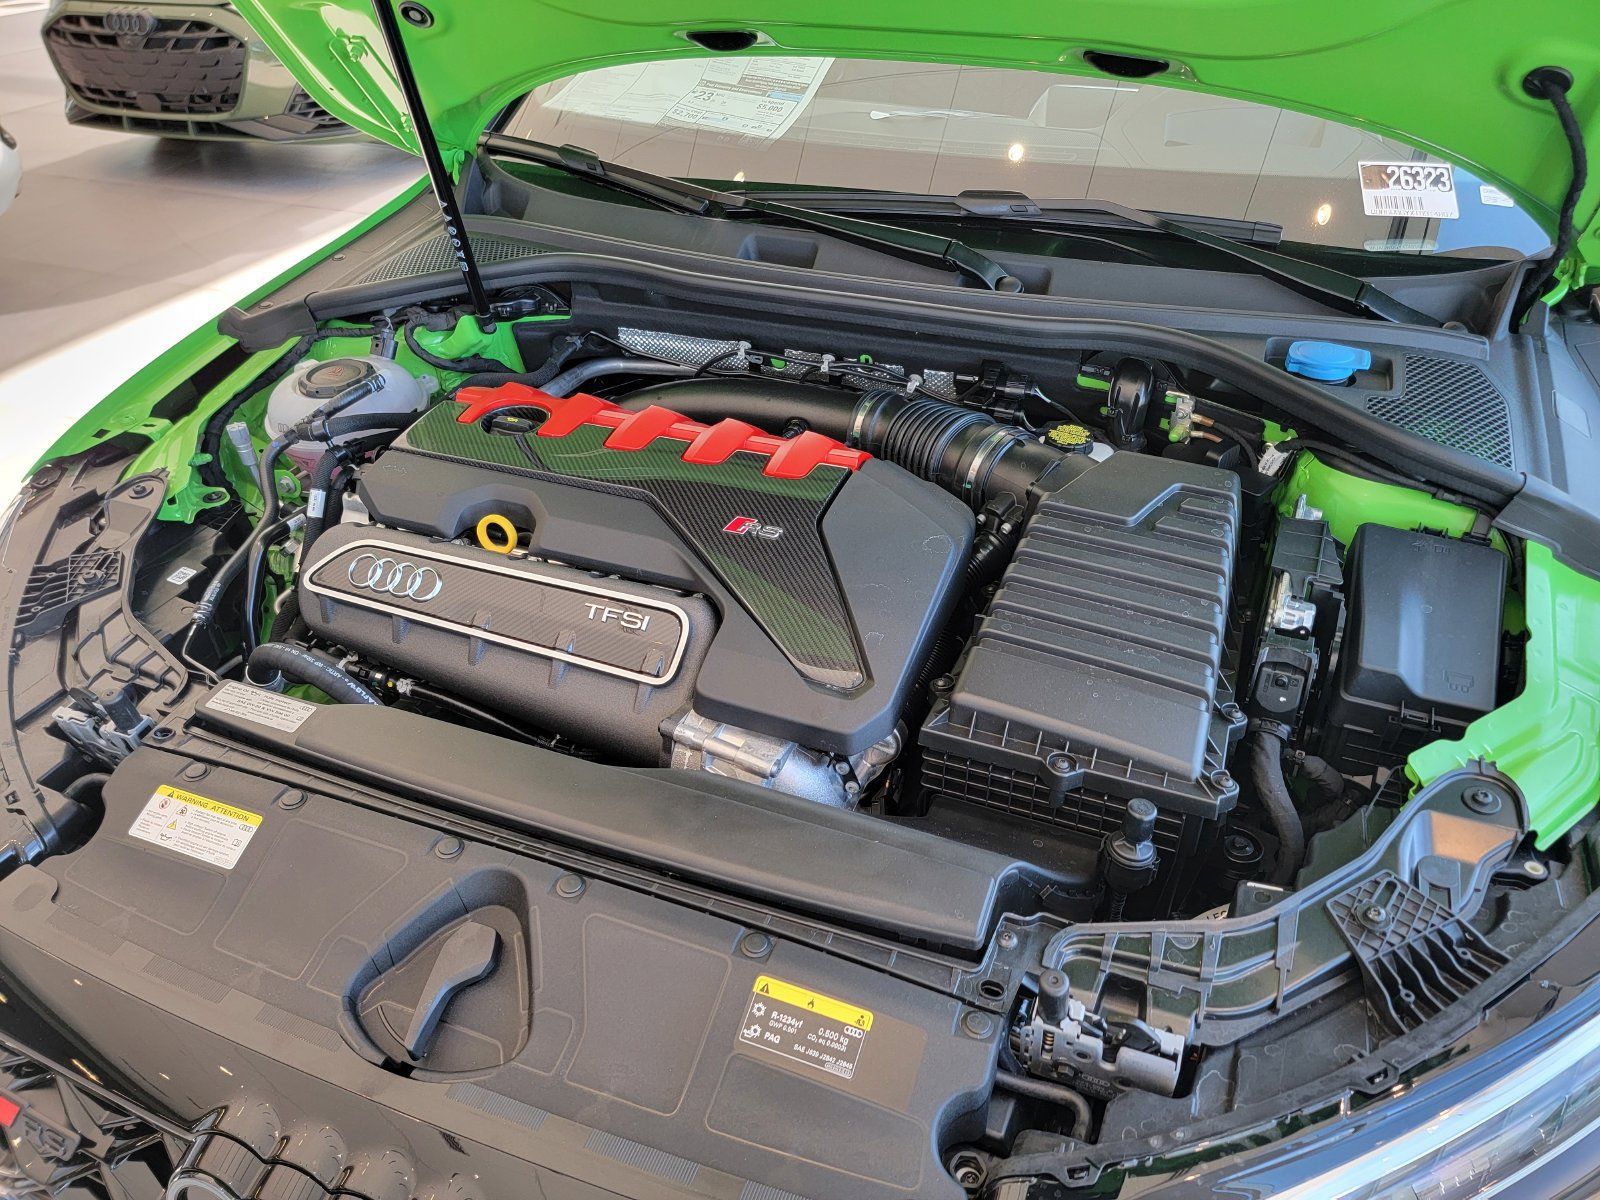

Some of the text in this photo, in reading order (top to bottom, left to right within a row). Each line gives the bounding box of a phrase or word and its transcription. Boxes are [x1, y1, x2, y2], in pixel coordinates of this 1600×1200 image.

[693, 91, 715, 101] 23
[1386, 166, 1450, 192] 26323
[733, 519, 783, 539] RS
[584, 602, 651, 631] TFSI
[176, 794, 208, 809] WARNING
[211, 805, 250, 822] ATTENTION
[771, 1011, 804, 1028] R-1234yf
[764, 1031, 781, 1044] PAG
[818, 1027, 849, 1046] 0.500 kg
